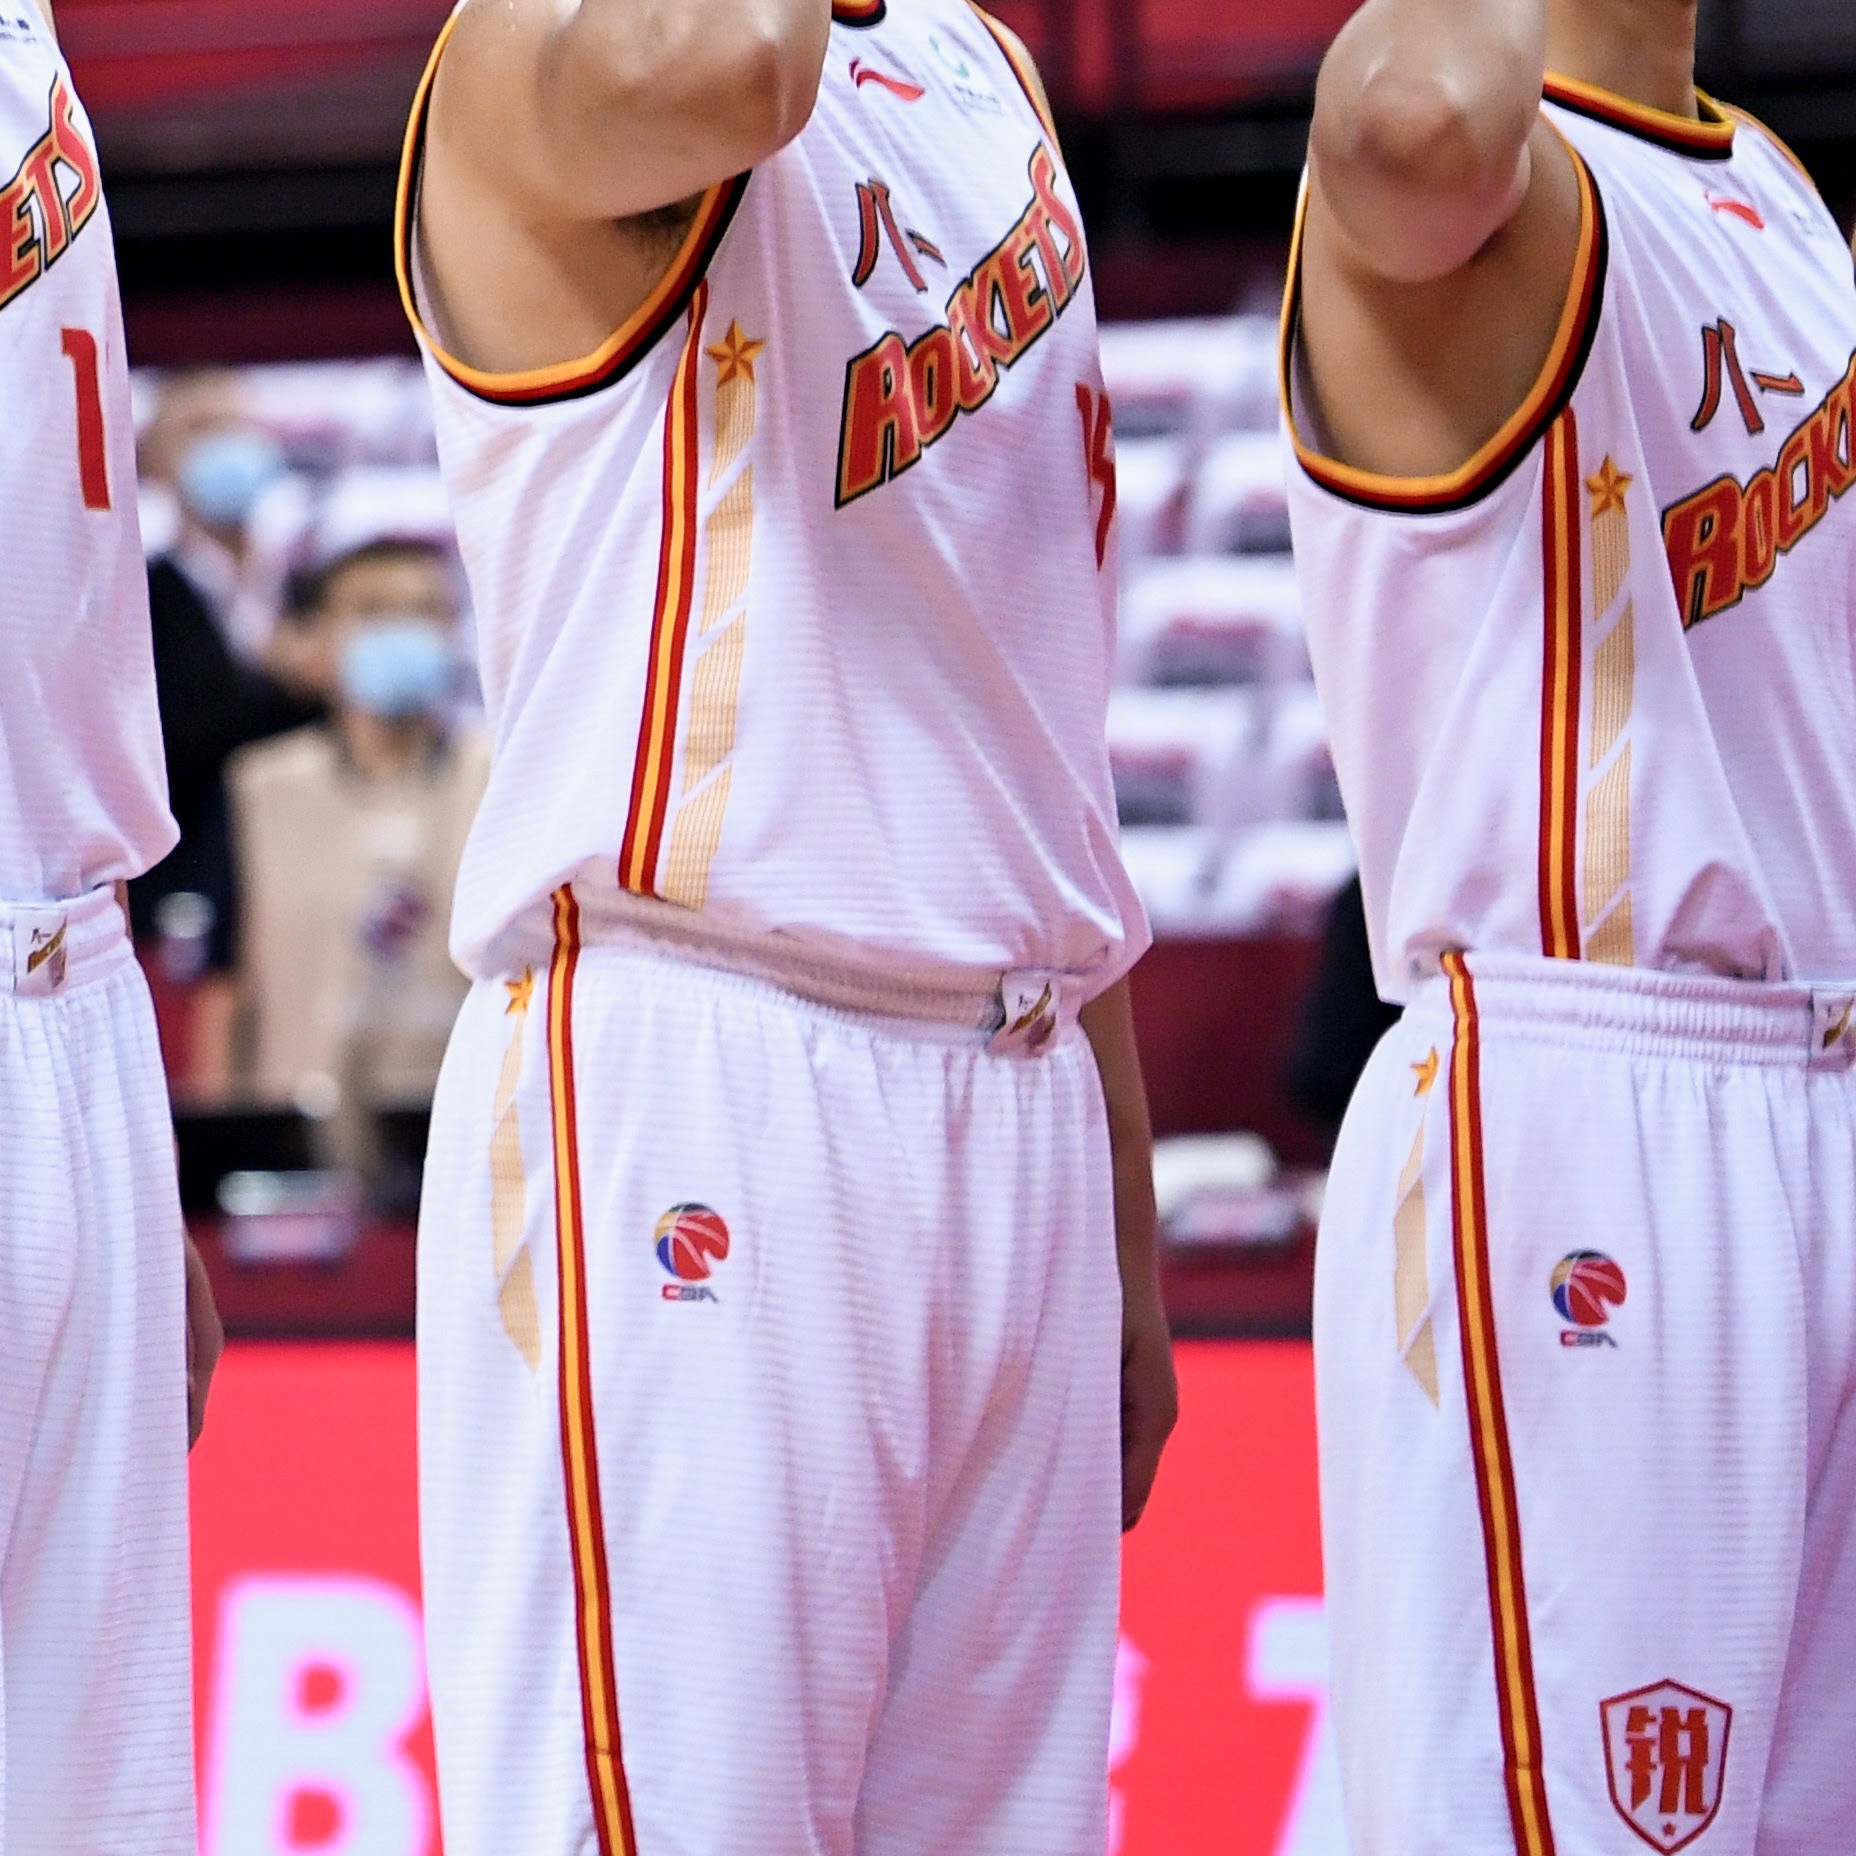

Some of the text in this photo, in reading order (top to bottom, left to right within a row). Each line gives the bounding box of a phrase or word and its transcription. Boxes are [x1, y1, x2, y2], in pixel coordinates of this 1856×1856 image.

[834, 140, 1087, 511] ROCKETS
[1690, 316, 1805, 434] 八一
[1625, 1705, 1709, 1814] 锐
